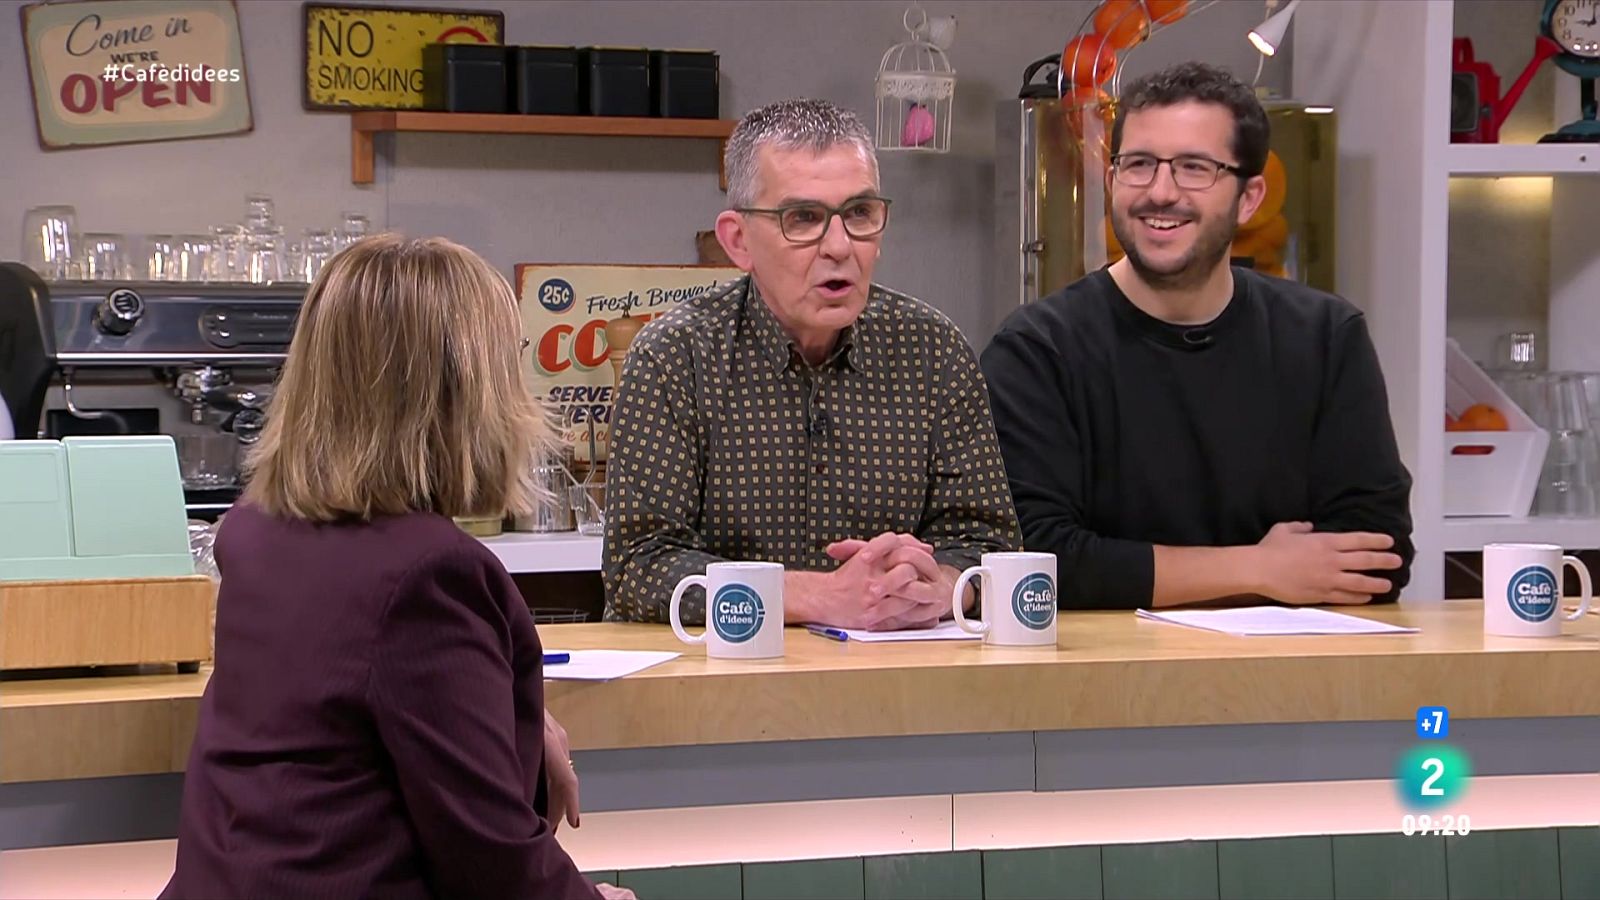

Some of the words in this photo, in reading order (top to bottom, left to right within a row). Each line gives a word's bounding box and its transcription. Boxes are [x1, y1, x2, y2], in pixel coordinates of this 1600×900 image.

[66, 14, 154, 57] Come
[165, 17, 192, 37] in
[318, 19, 374, 58] NO
[60, 64, 212, 114] OPEN
[543, 285, 570, 305] 25¢
[586, 291, 642, 314] Fresh
[547, 386, 615, 402] SERVE
[719, 601, 753, 614] Cafè
[719, 615, 753, 624] d'idees
